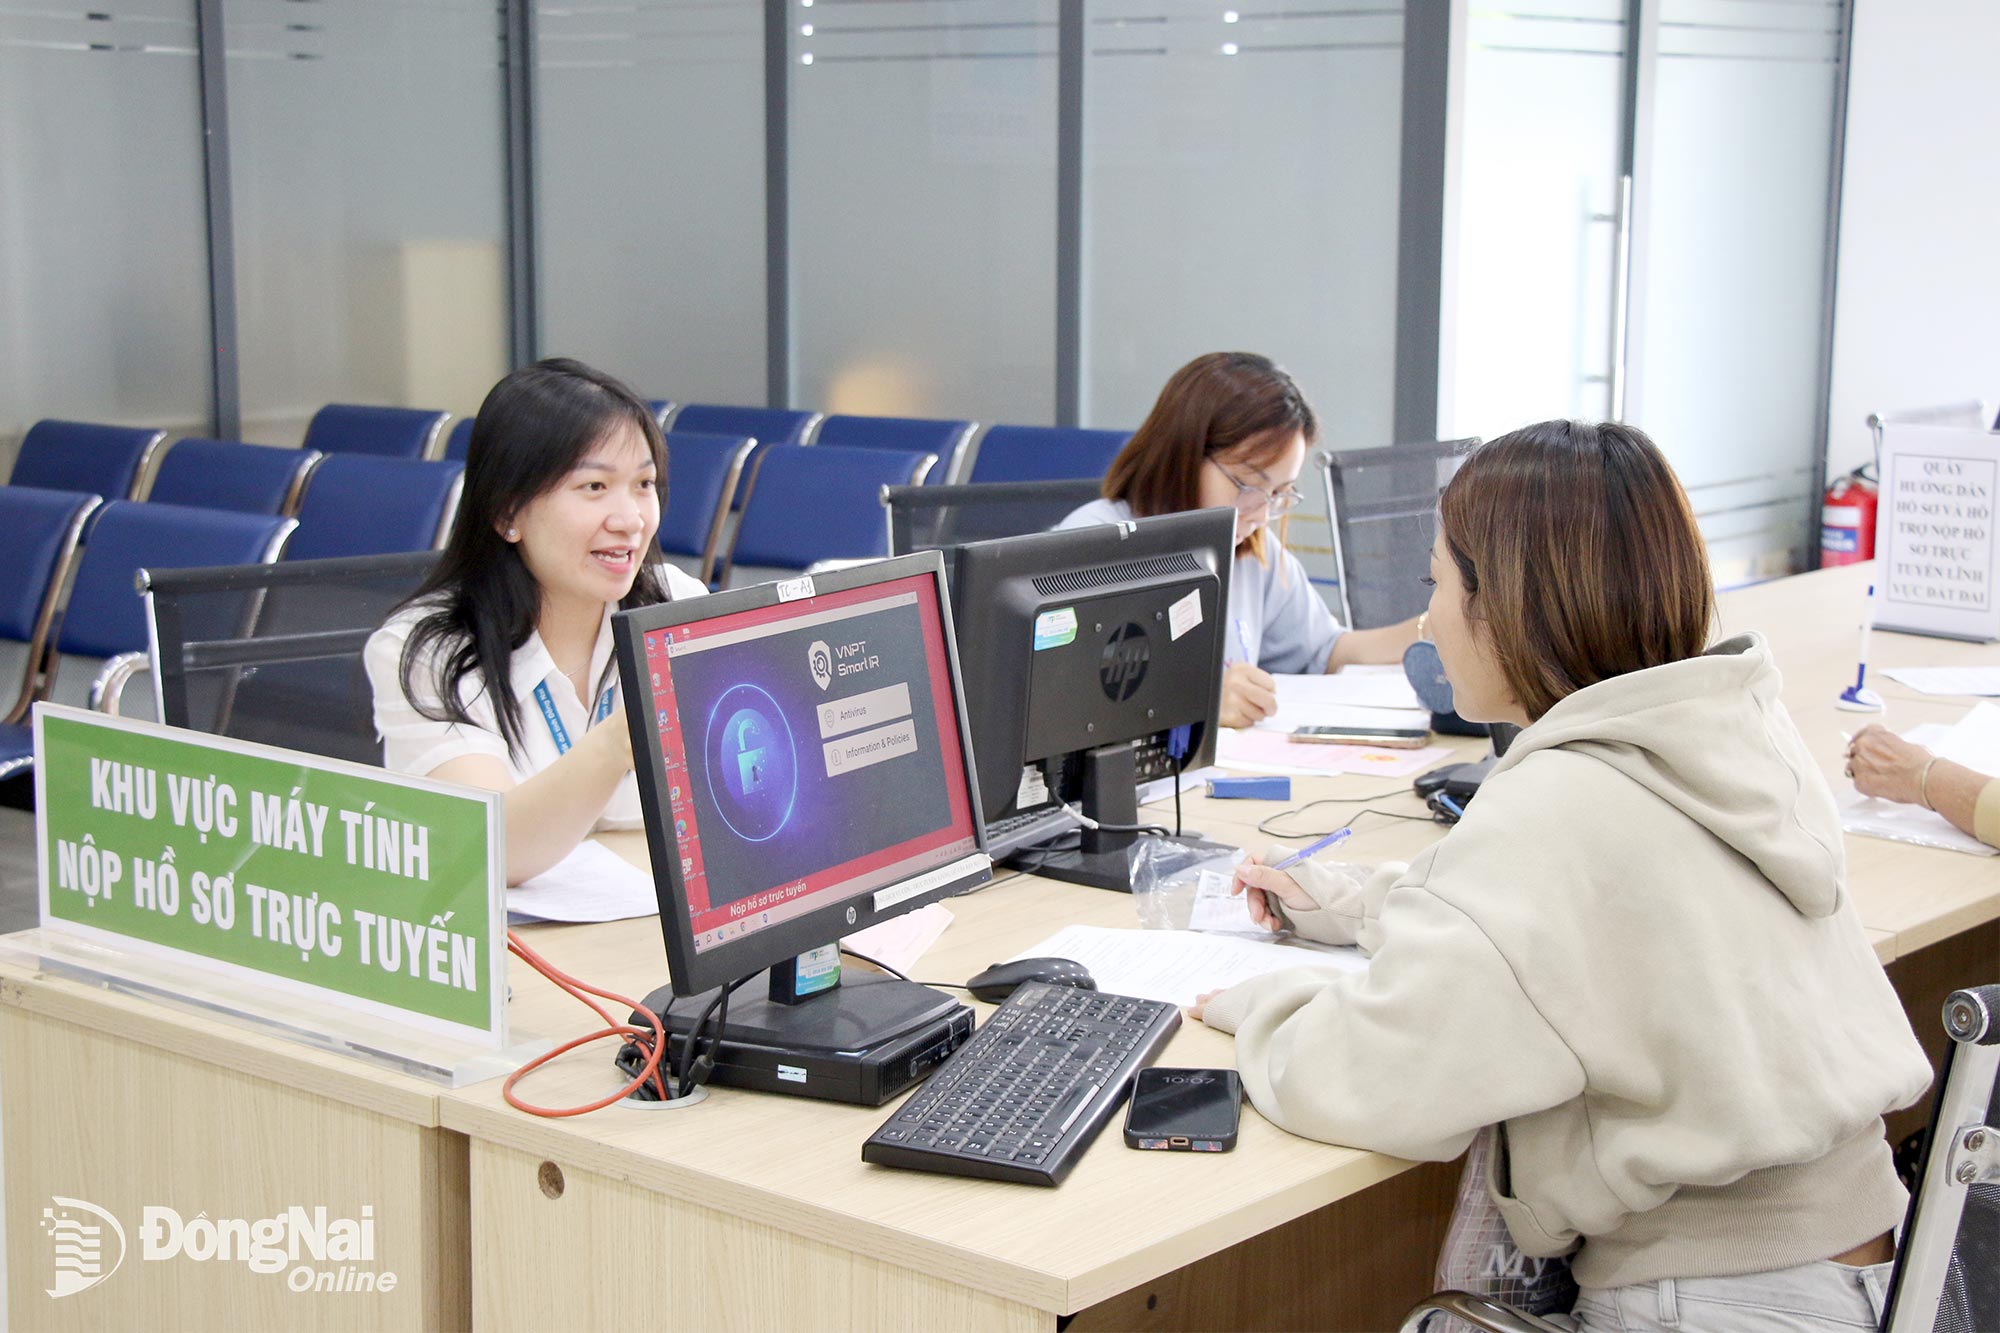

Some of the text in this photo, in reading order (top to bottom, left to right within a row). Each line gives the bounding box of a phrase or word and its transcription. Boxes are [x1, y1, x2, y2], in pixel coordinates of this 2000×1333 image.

[834, 641, 866, 659] VNPT
[838, 657, 869, 677] Smart
[840, 706, 867, 721] Antivirus
[845, 741, 881, 759] Information
[886, 733, 910, 747] Policies
[92, 758, 430, 881] KHU VỰC MÁY TÍNH
[730, 904, 746, 918] Nộp
[747, 895, 758, 910] hồ
[759, 896, 768, 907] sơ
[769, 890, 785, 905] trực
[785, 879, 807, 898] tuyến
[57, 833, 478, 992] NỘP HỒ SƠ TRỰC TUYẾN
[1162, 1076, 1216, 1084] 10:07
